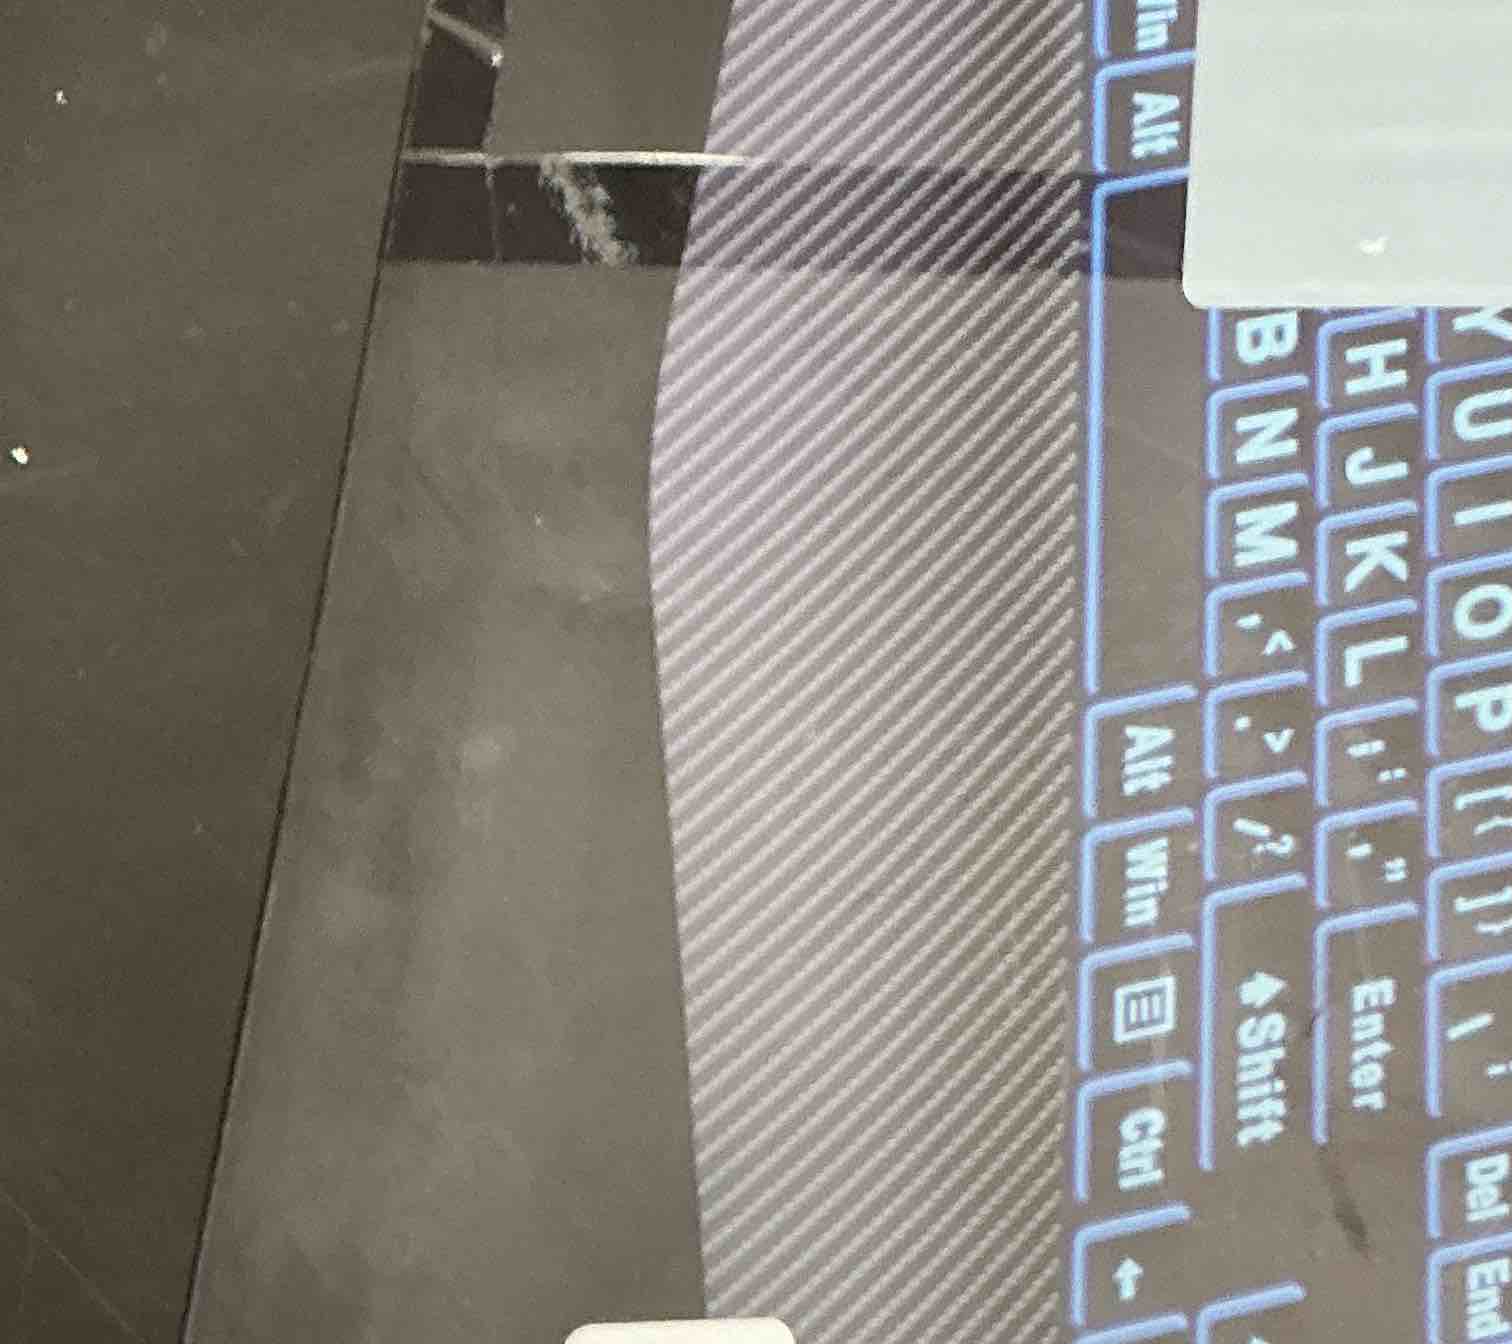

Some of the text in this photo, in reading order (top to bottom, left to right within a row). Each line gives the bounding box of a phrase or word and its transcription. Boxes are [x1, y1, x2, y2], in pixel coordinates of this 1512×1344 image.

[1130, 92, 1180, 159] Alt
[1235, 310, 1298, 364] B
[1344, 338, 1407, 396] H
[1234, 407, 1299, 465] N
[1344, 446, 1408, 485] J
[1233, 501, 1298, 568] M
[1342, 530, 1408, 593] K
[1343, 635, 1407, 688] L
[1122, 725, 1174, 796] Alt
[1123, 837, 1168, 926] Win
[1349, 978, 1396, 1110] Enter
[1235, 1012, 1286, 1147] Shift
[1117, 1107, 1165, 1189] Ctrl
[1465, 1153, 1509, 1222] Del
[1465, 1257, 1512, 1341] End
